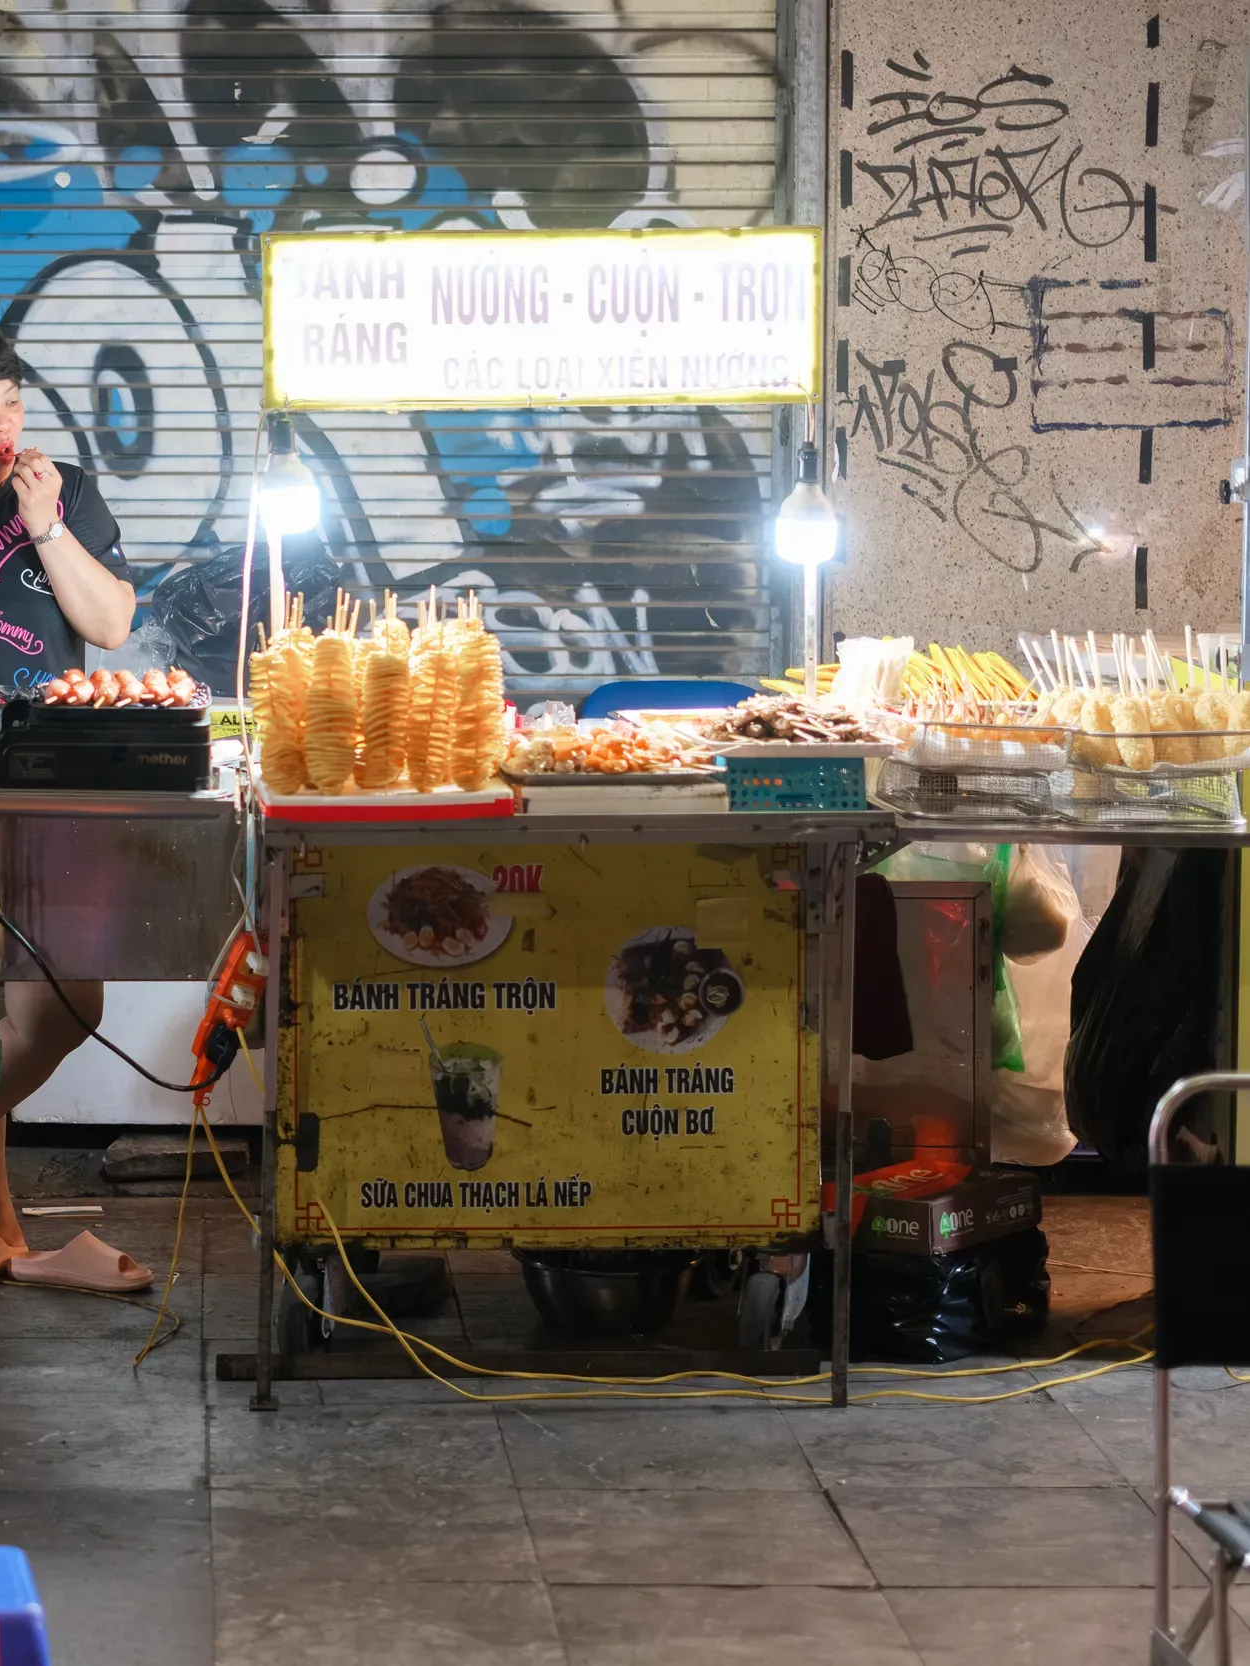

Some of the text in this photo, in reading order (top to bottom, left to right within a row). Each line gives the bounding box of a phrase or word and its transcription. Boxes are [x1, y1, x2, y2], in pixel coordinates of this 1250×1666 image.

[287, 314, 409, 365] RÁNG
[220, 713, 258, 726] ALL
[333, 977, 556, 1016] BÁNH TRÁNG TRỘN
[601, 1062, 734, 1095] BÁNH TRÁNG
[621, 1103, 715, 1142] CUỘN BƠ
[360, 1174, 592, 1215] SỮA CHUA THẠCH LÁ NẾP
